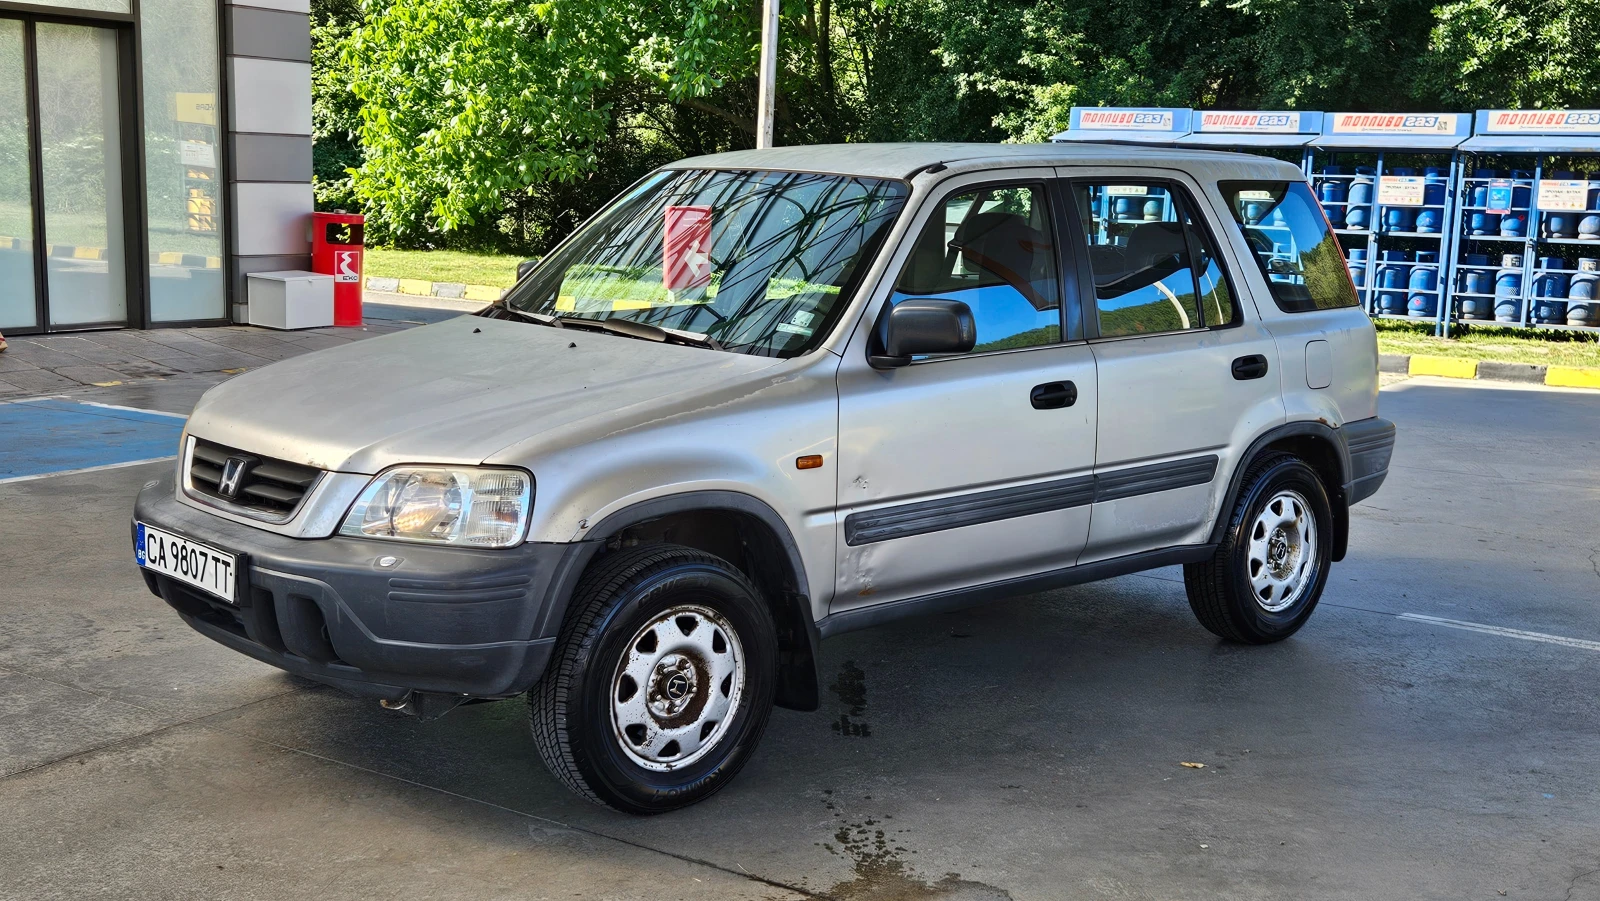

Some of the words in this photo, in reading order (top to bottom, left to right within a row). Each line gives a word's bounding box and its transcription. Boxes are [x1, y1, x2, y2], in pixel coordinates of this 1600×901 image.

[137, 549, 146, 560] BG
[147, 533, 168, 570] CA
[170, 541, 209, 583] 9807
[211, 555, 231, 594] TT
